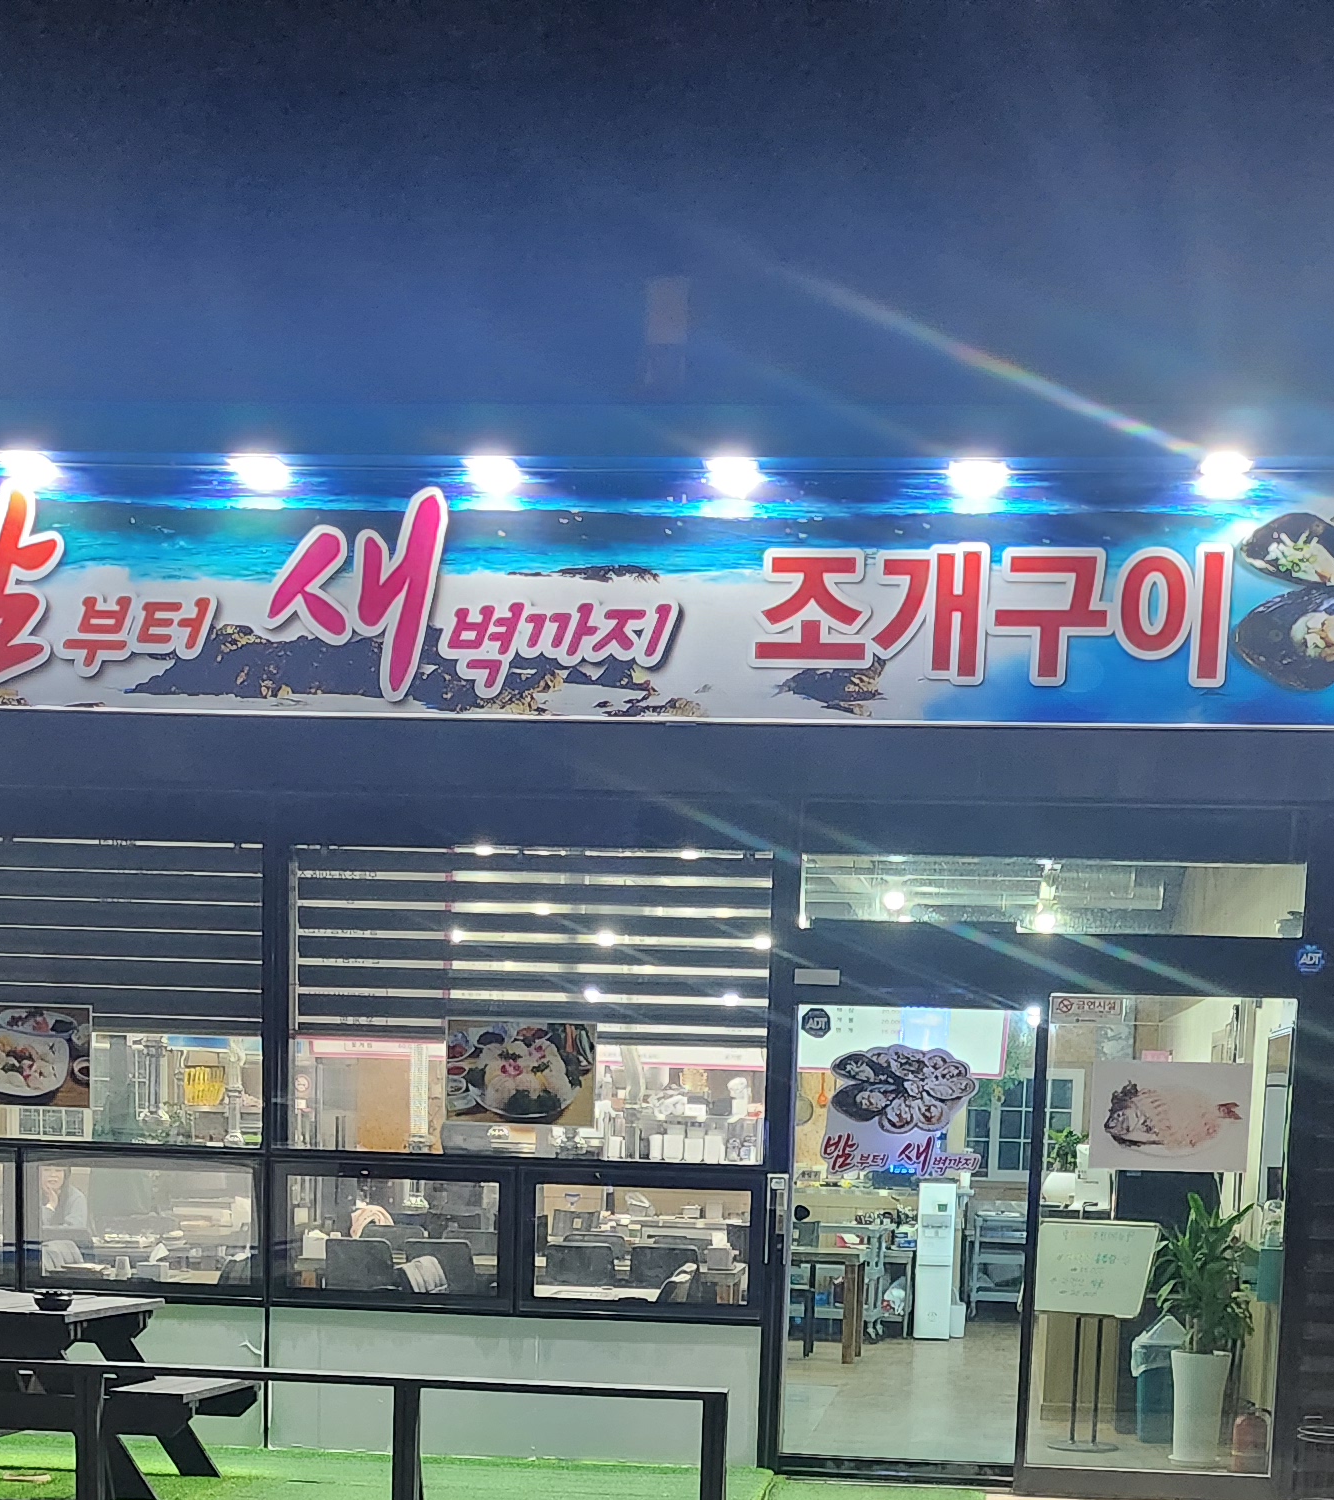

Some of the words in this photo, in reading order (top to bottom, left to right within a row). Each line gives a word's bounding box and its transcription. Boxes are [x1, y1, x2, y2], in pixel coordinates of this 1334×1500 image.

[753, 548, 1229, 684] 조개구이
[1299, 953, 1322, 965] ADT
[1076, 999, 1116, 1011] 금연시설
[806, 1017, 827, 1029] ADT
